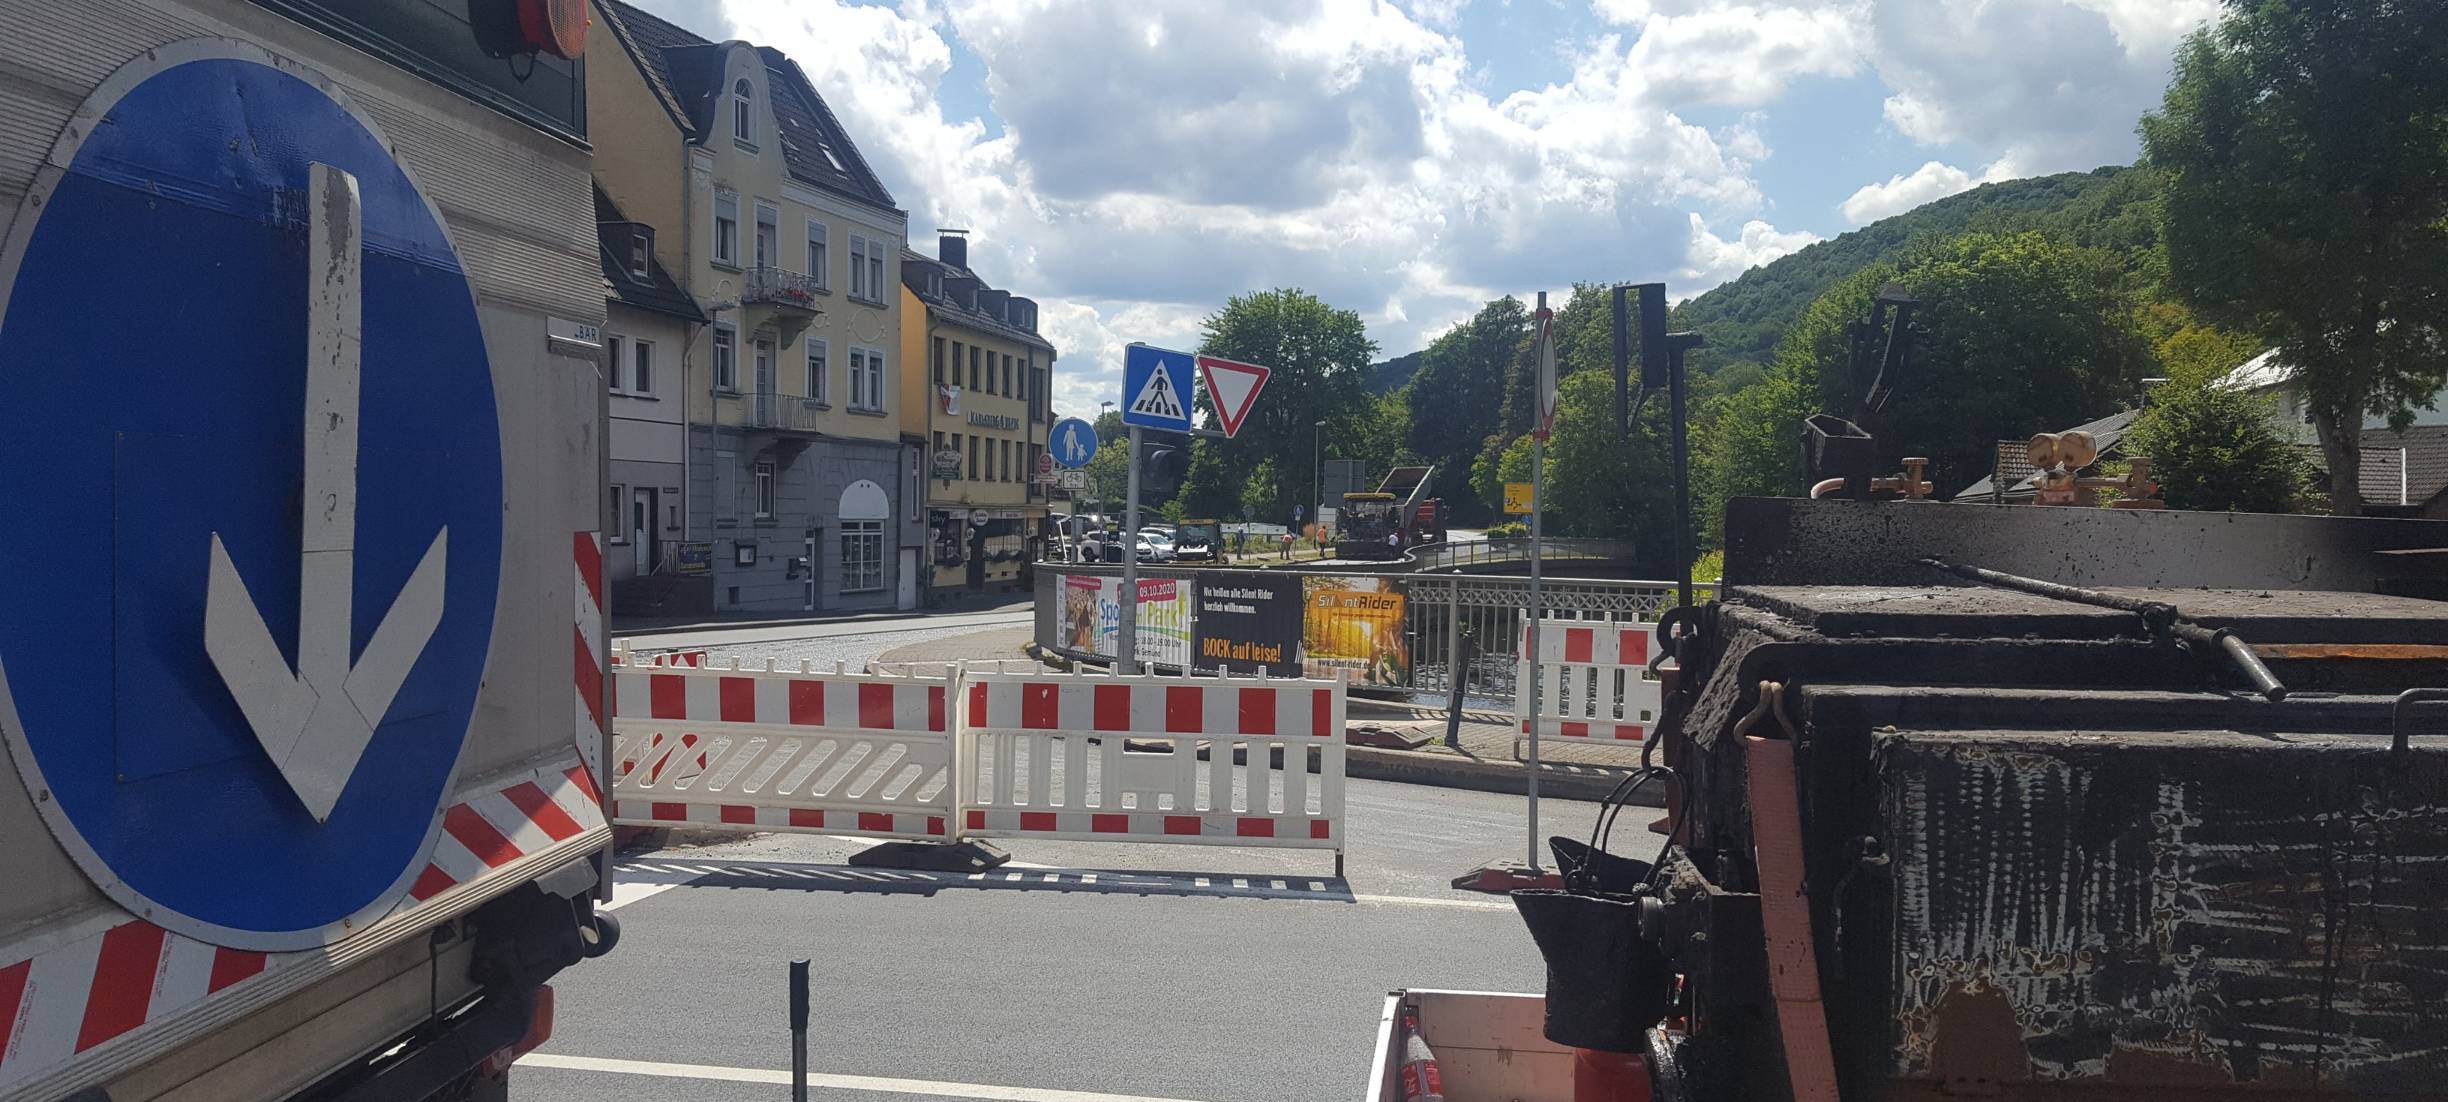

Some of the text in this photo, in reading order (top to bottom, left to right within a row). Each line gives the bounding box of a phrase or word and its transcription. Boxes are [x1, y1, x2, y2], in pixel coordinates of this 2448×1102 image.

[1139, 582, 1175, 598] 09.10.2020
[1230, 588, 1241, 598] alle
[1241, 588, 1257, 599] Silent
[1257, 588, 1274, 600] Rider
[1100, 598, 1120, 626] Spo
[1147, 600, 1178, 627] Park
[1171, 639, 1182, 649] Uhr
[1203, 638, 1281, 663] BOCK auf leise!
